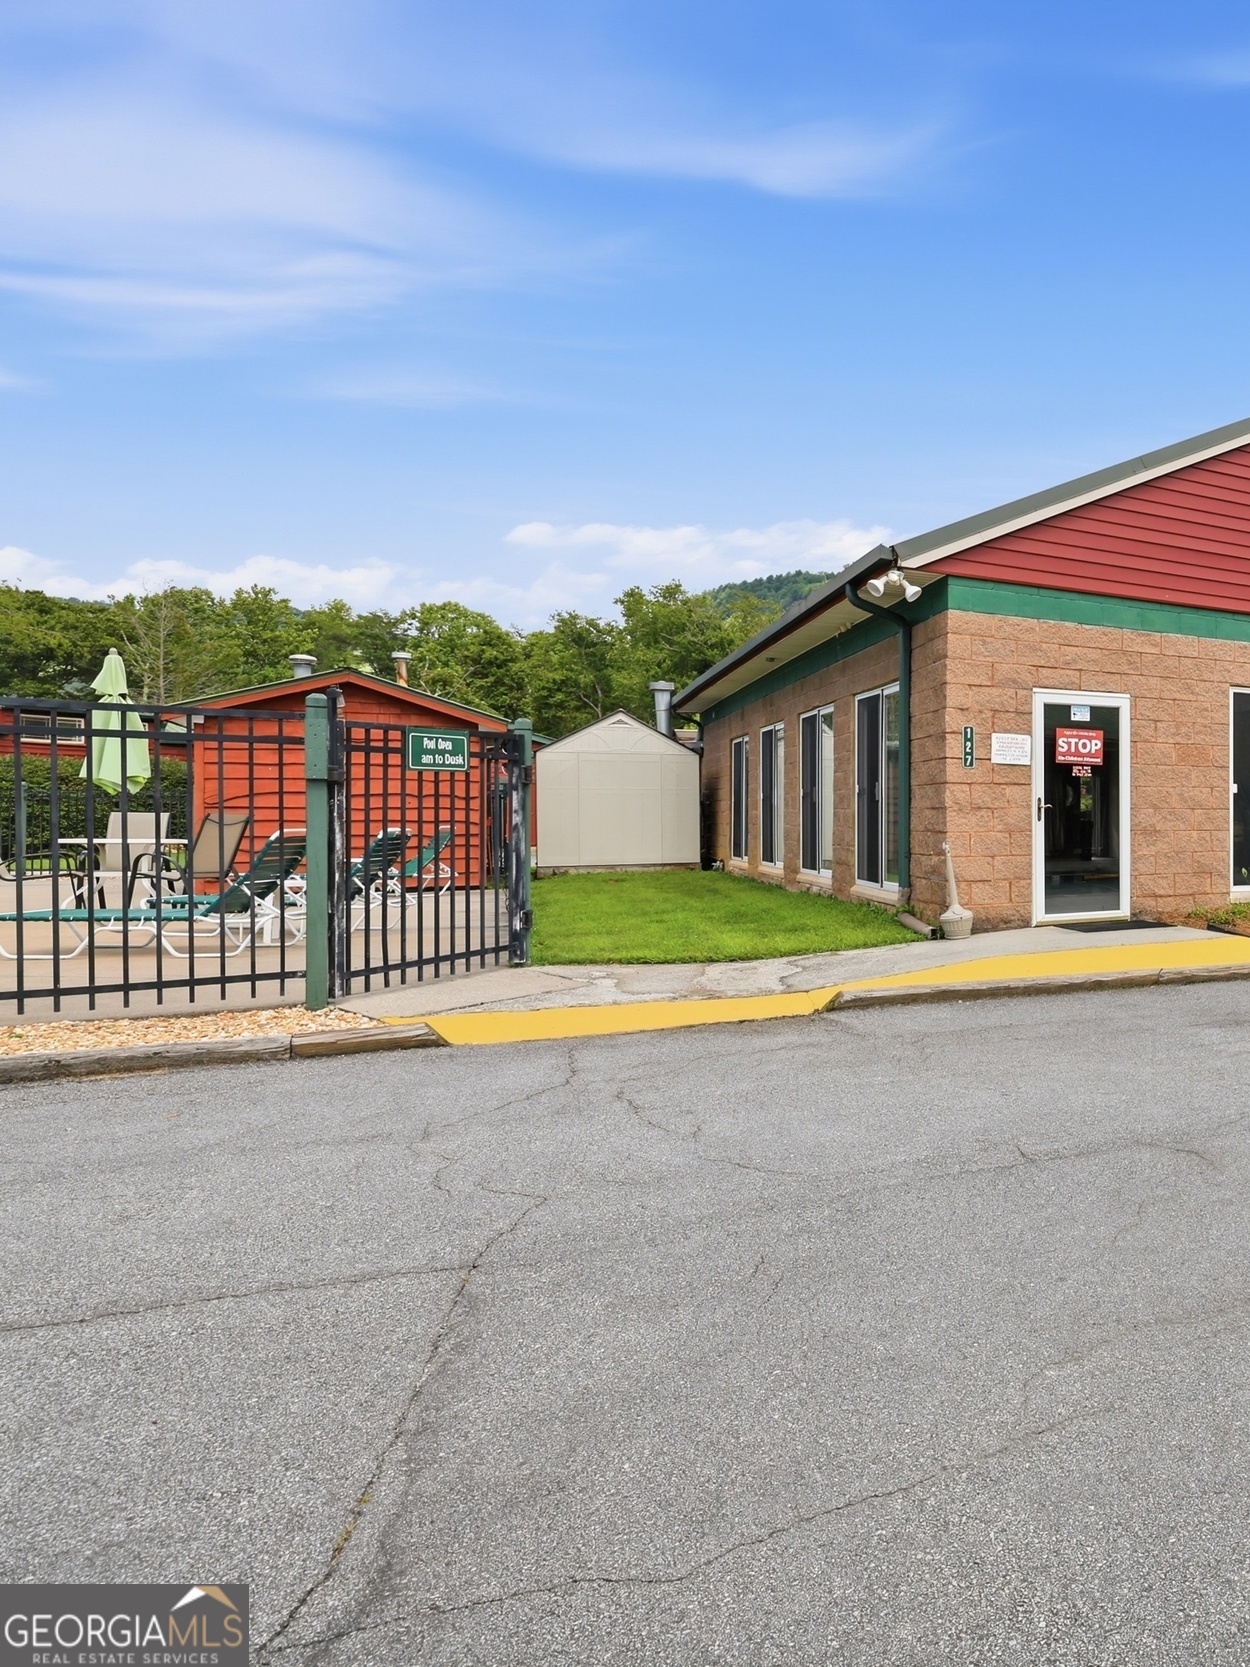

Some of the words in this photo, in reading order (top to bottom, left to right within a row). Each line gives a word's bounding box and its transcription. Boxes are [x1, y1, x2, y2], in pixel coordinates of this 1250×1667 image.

[423, 737, 436, 749] Pool
[437, 738, 452, 750] Open
[1058, 737, 1102, 754] STOP
[421, 754, 434, 764] am
[435, 754, 443, 764] to
[444, 753, 464, 765] Dusk
